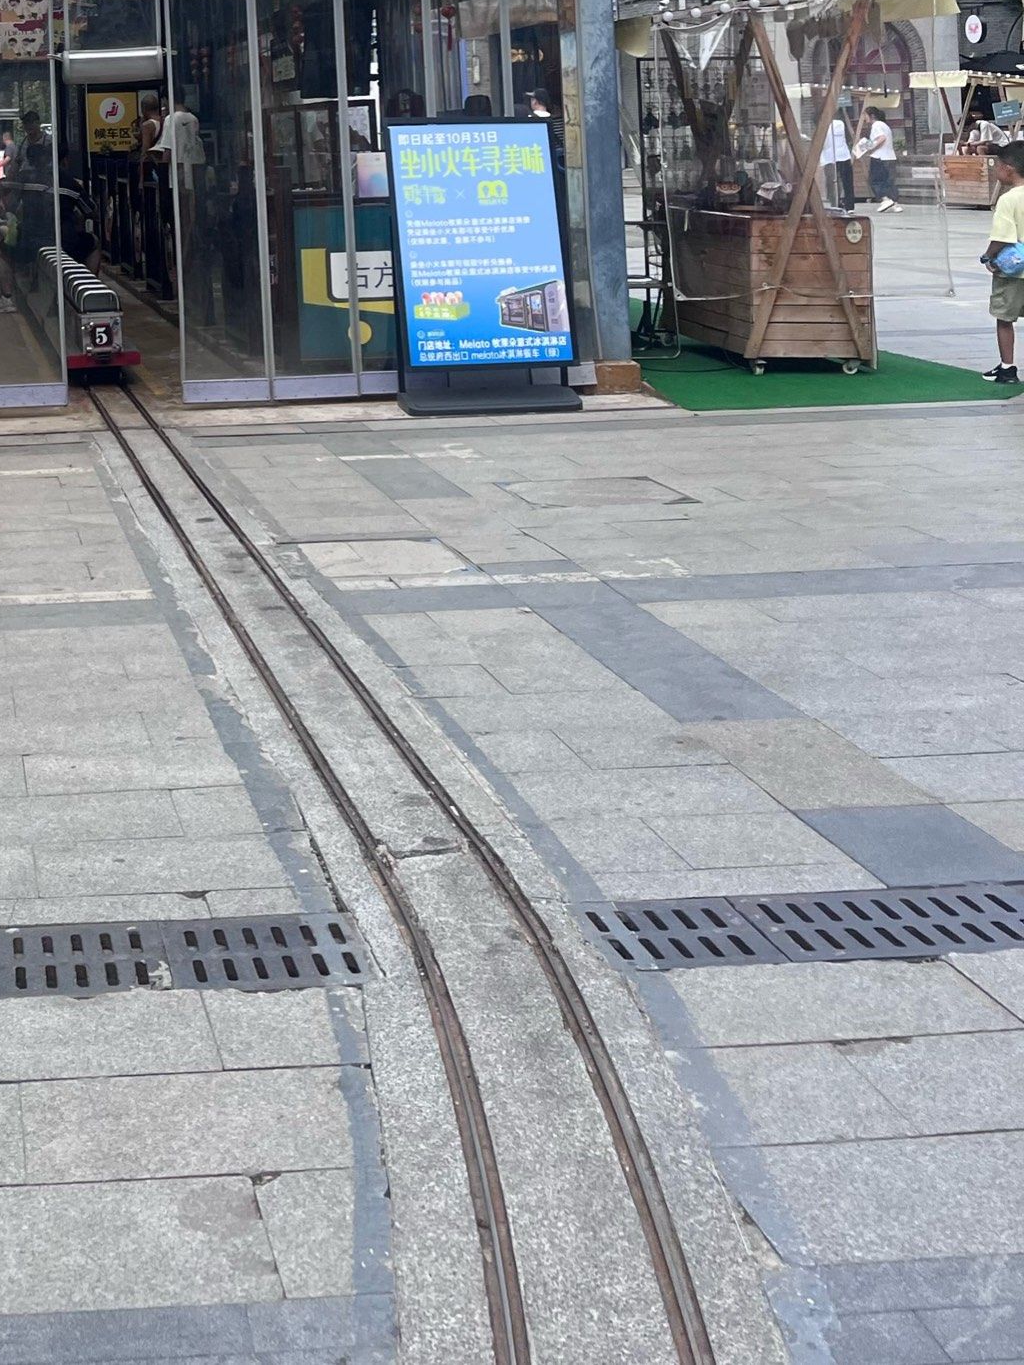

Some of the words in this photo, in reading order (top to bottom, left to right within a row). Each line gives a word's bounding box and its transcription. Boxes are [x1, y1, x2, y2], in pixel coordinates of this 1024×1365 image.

[94, 127, 132, 140] 候车区
[397, 131, 498, 146] 即日起至10月31日
[399, 143, 545, 180] 坐小火车寻美味
[94, 327, 109, 345] 5
